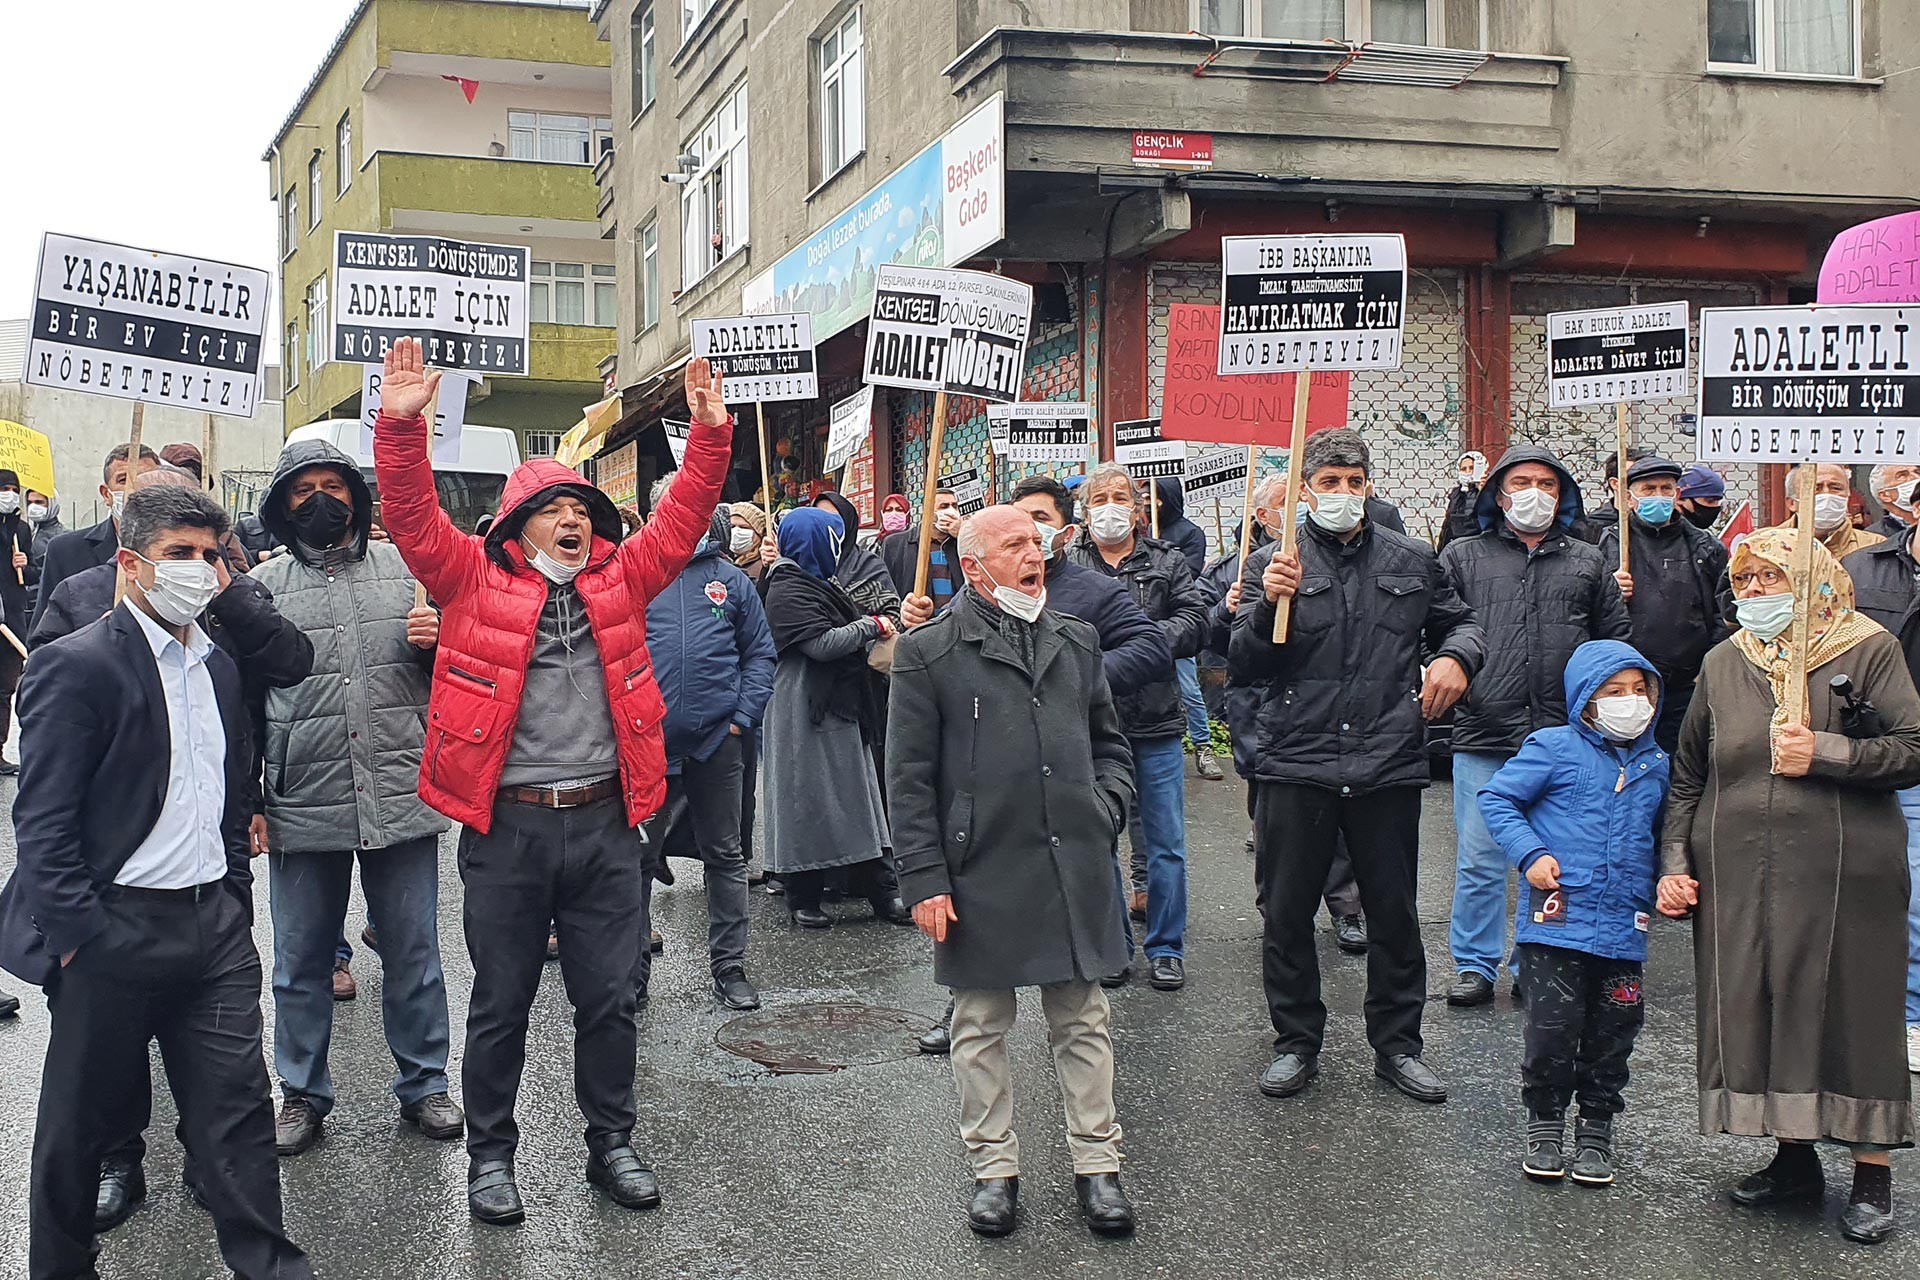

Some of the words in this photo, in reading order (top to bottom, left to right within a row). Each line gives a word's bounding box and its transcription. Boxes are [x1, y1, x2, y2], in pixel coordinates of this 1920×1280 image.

[1136, 135, 1184, 149] GENÇLİK
[947, 135, 998, 193] Başkent
[959, 188, 988, 227] Gıda
[807, 236, 831, 268] Doğal
[832, 214, 857, 253] lezzet
[858, 190, 893, 232] burada.
[346, 242, 418, 267] KENTSEL
[428, 242, 518, 278] DÖNÜŞÜMDE
[1259, 243, 1284, 269] İBB
[1293, 246, 1372, 273] BAŞKANINA
[63, 255, 250, 320] YAŞANABİLİR
[932, 280, 946, 290] ADA
[958, 282, 983, 294] PARSEL
[1258, 277, 1287, 295] İMZALI
[1834, 259, 1919, 294] ADALET
[348, 283, 437, 319] ADALET
[454, 281, 510, 333] İÇİN
[876, 295, 938, 324] KENTSEL
[940, 297, 1026, 336] DÖNÜŞÜMDE
[1227, 302, 1345, 332] HATIRLATMAK
[1355, 294, 1399, 330] İÇİN
[1564, 319, 1584, 335] HAK
[1591, 315, 1625, 333] HUKUK
[1631, 312, 1671, 330] ADALET
[48, 308, 97, 340] BİR
[124, 323, 155, 348] EV
[180, 326, 247, 365] İÇİN
[344, 329, 520, 368] NÖBTEYİZ!
[708, 316, 800, 353] ADALETLİ
[1174, 338, 1218, 358] YAPTI
[1229, 334, 1394, 366] NÖBETTEYİZ!
[1730, 310, 1909, 372] ADALETLİ
[732, 355, 772, 375] DÖNÜŞÜM
[776, 353, 799, 373] İÇİN
[870, 331, 948, 382] ADALET
[947, 330, 1020, 394] NÖBETİ
[1554, 355, 1604, 373] ADALETE
[1611, 351, 1647, 369] DAVET
[1655, 347, 1683, 368] İÇİN
[38, 350, 249, 409] NÖBETTEYİZ!
[724, 377, 812, 398] BETTEYİZ!
[1558, 374, 1682, 401] NÖBETTEYİZ!
[1731, 379, 1763, 408] BİR
[1772, 379, 1849, 413] DÖNÜŞÜM
[1860, 378, 1904, 413] İÇİN
[1011, 431, 1056, 444] OLMASIN
[1062, 429, 1087, 444] DİYE
[1711, 421, 1920, 455] NÖBETTEYİZ
[1188, 450, 1245, 477] YAŞANABİLİR
[1542, 890, 1560, 916] 6
